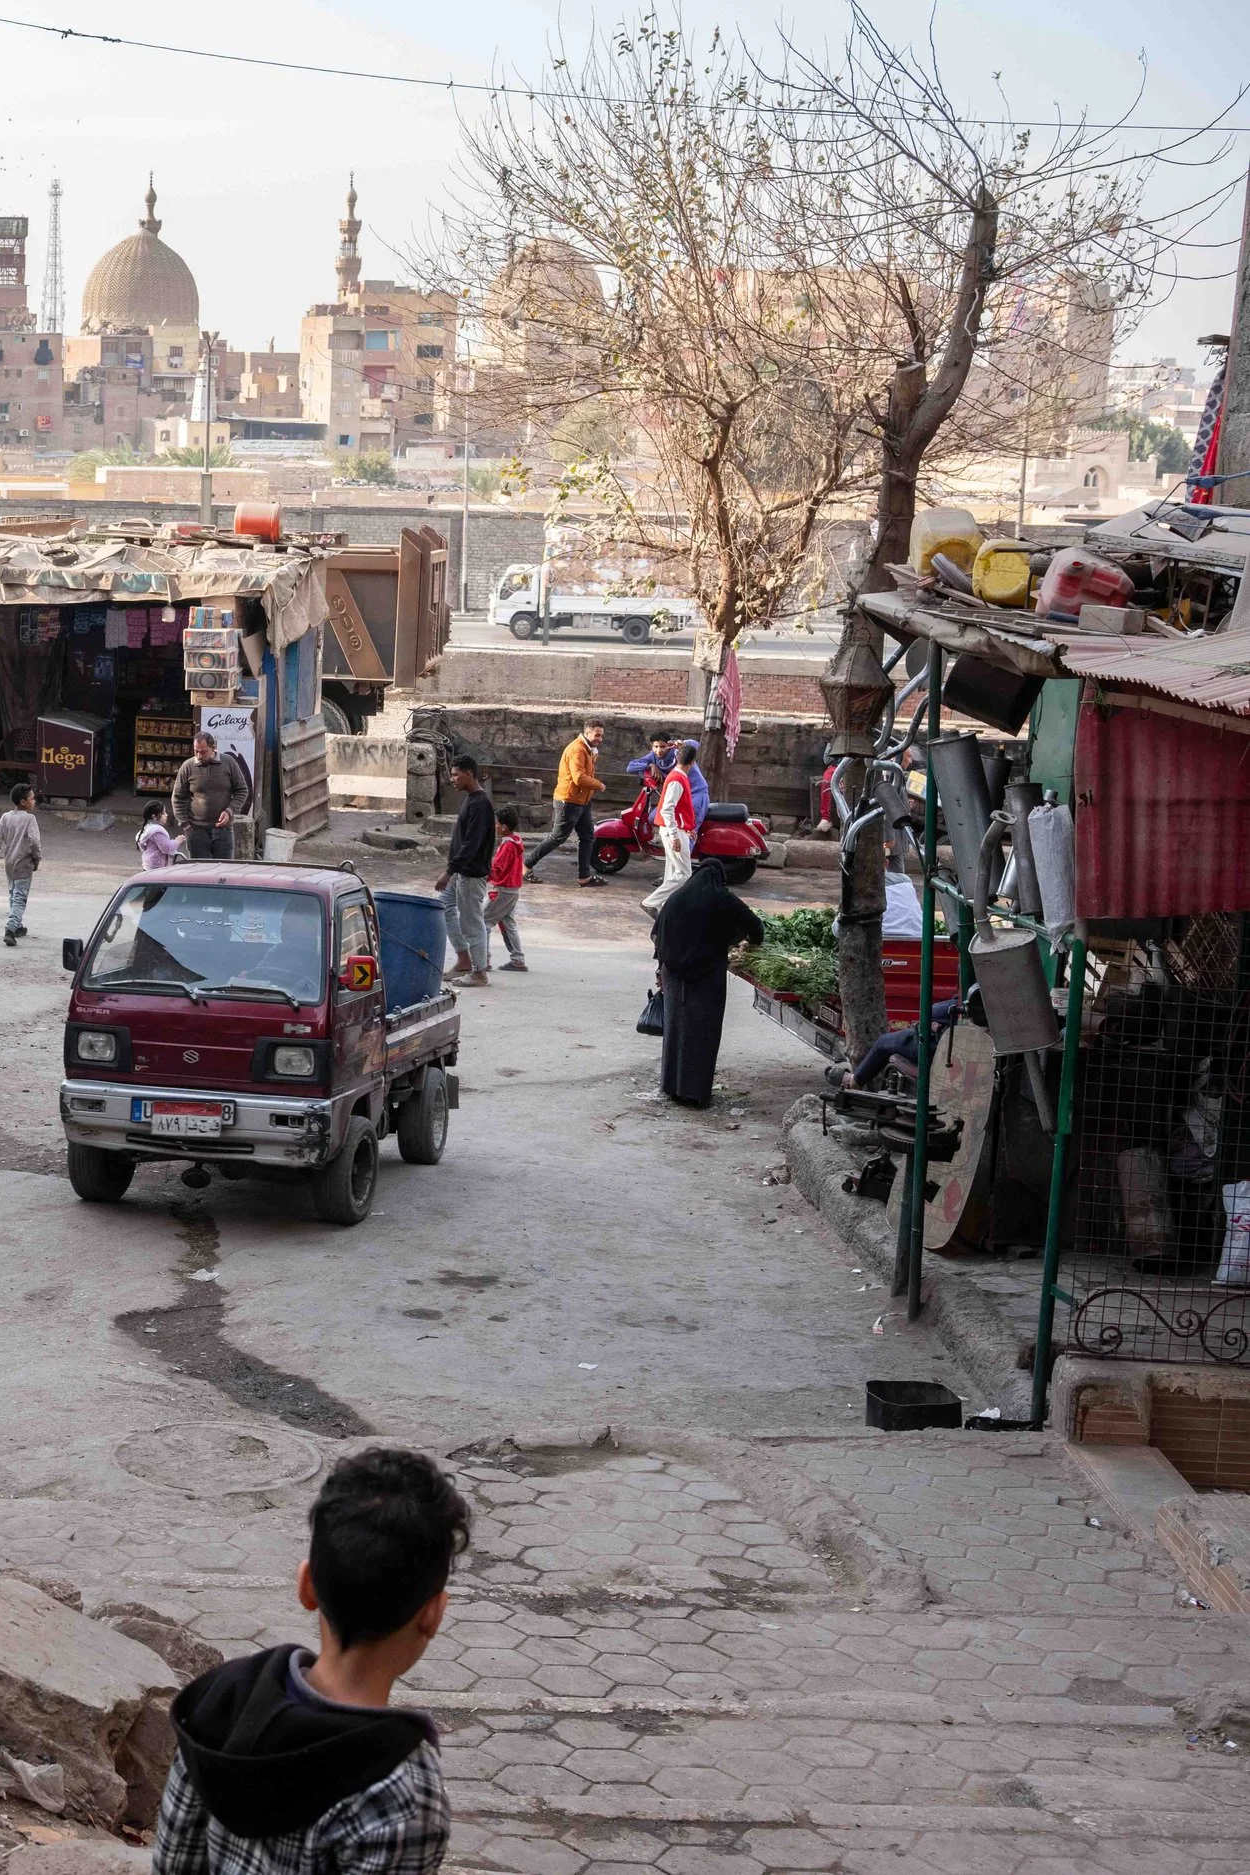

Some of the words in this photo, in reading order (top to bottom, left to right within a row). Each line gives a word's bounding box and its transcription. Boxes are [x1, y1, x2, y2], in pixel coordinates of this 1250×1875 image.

[207, 713, 249, 731] Galaxy
[40, 746, 87, 770] Mega
[76, 1006, 110, 1014] SUPER
[157, 1116, 181, 1132] ٨٧٩
